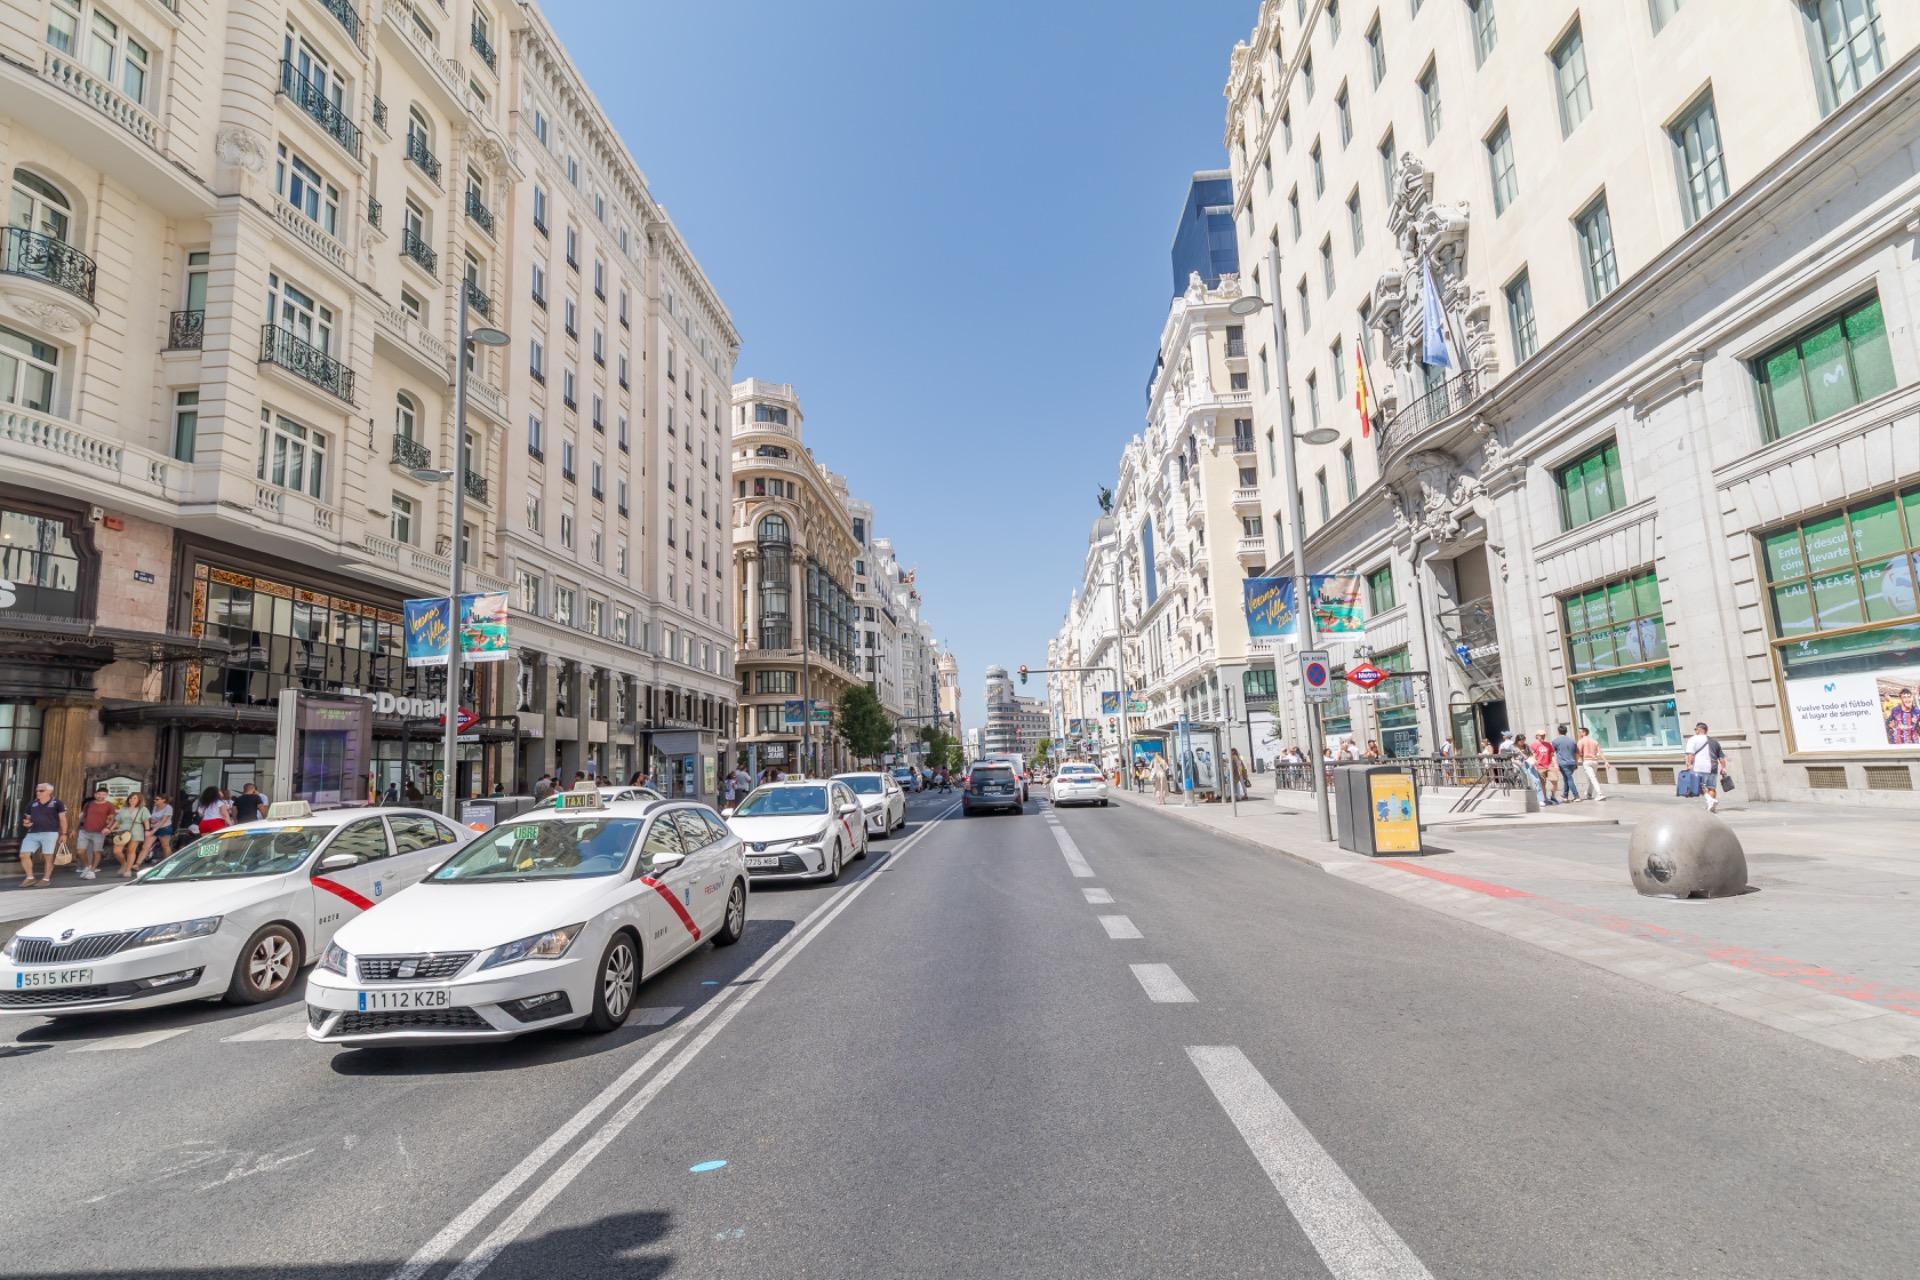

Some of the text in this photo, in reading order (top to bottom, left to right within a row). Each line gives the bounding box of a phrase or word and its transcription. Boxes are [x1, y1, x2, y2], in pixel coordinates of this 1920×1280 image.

[1781, 558, 1805, 572] cóm
[1809, 548, 1850, 565] llevarte
[1826, 577, 1840, 588] EA
[1796, 704, 1820, 712] Vuelve
[1822, 702, 1839, 710] todo
[1809, 711, 1828, 720] lugar
[1830, 710, 1838, 718] de
[566, 795, 585, 807] TAXI
[516, 826, 538, 839] LIBRE
[25, 969, 87, 986] 5515 KFF
[371, 990, 446, 1008] 1112 KZB
